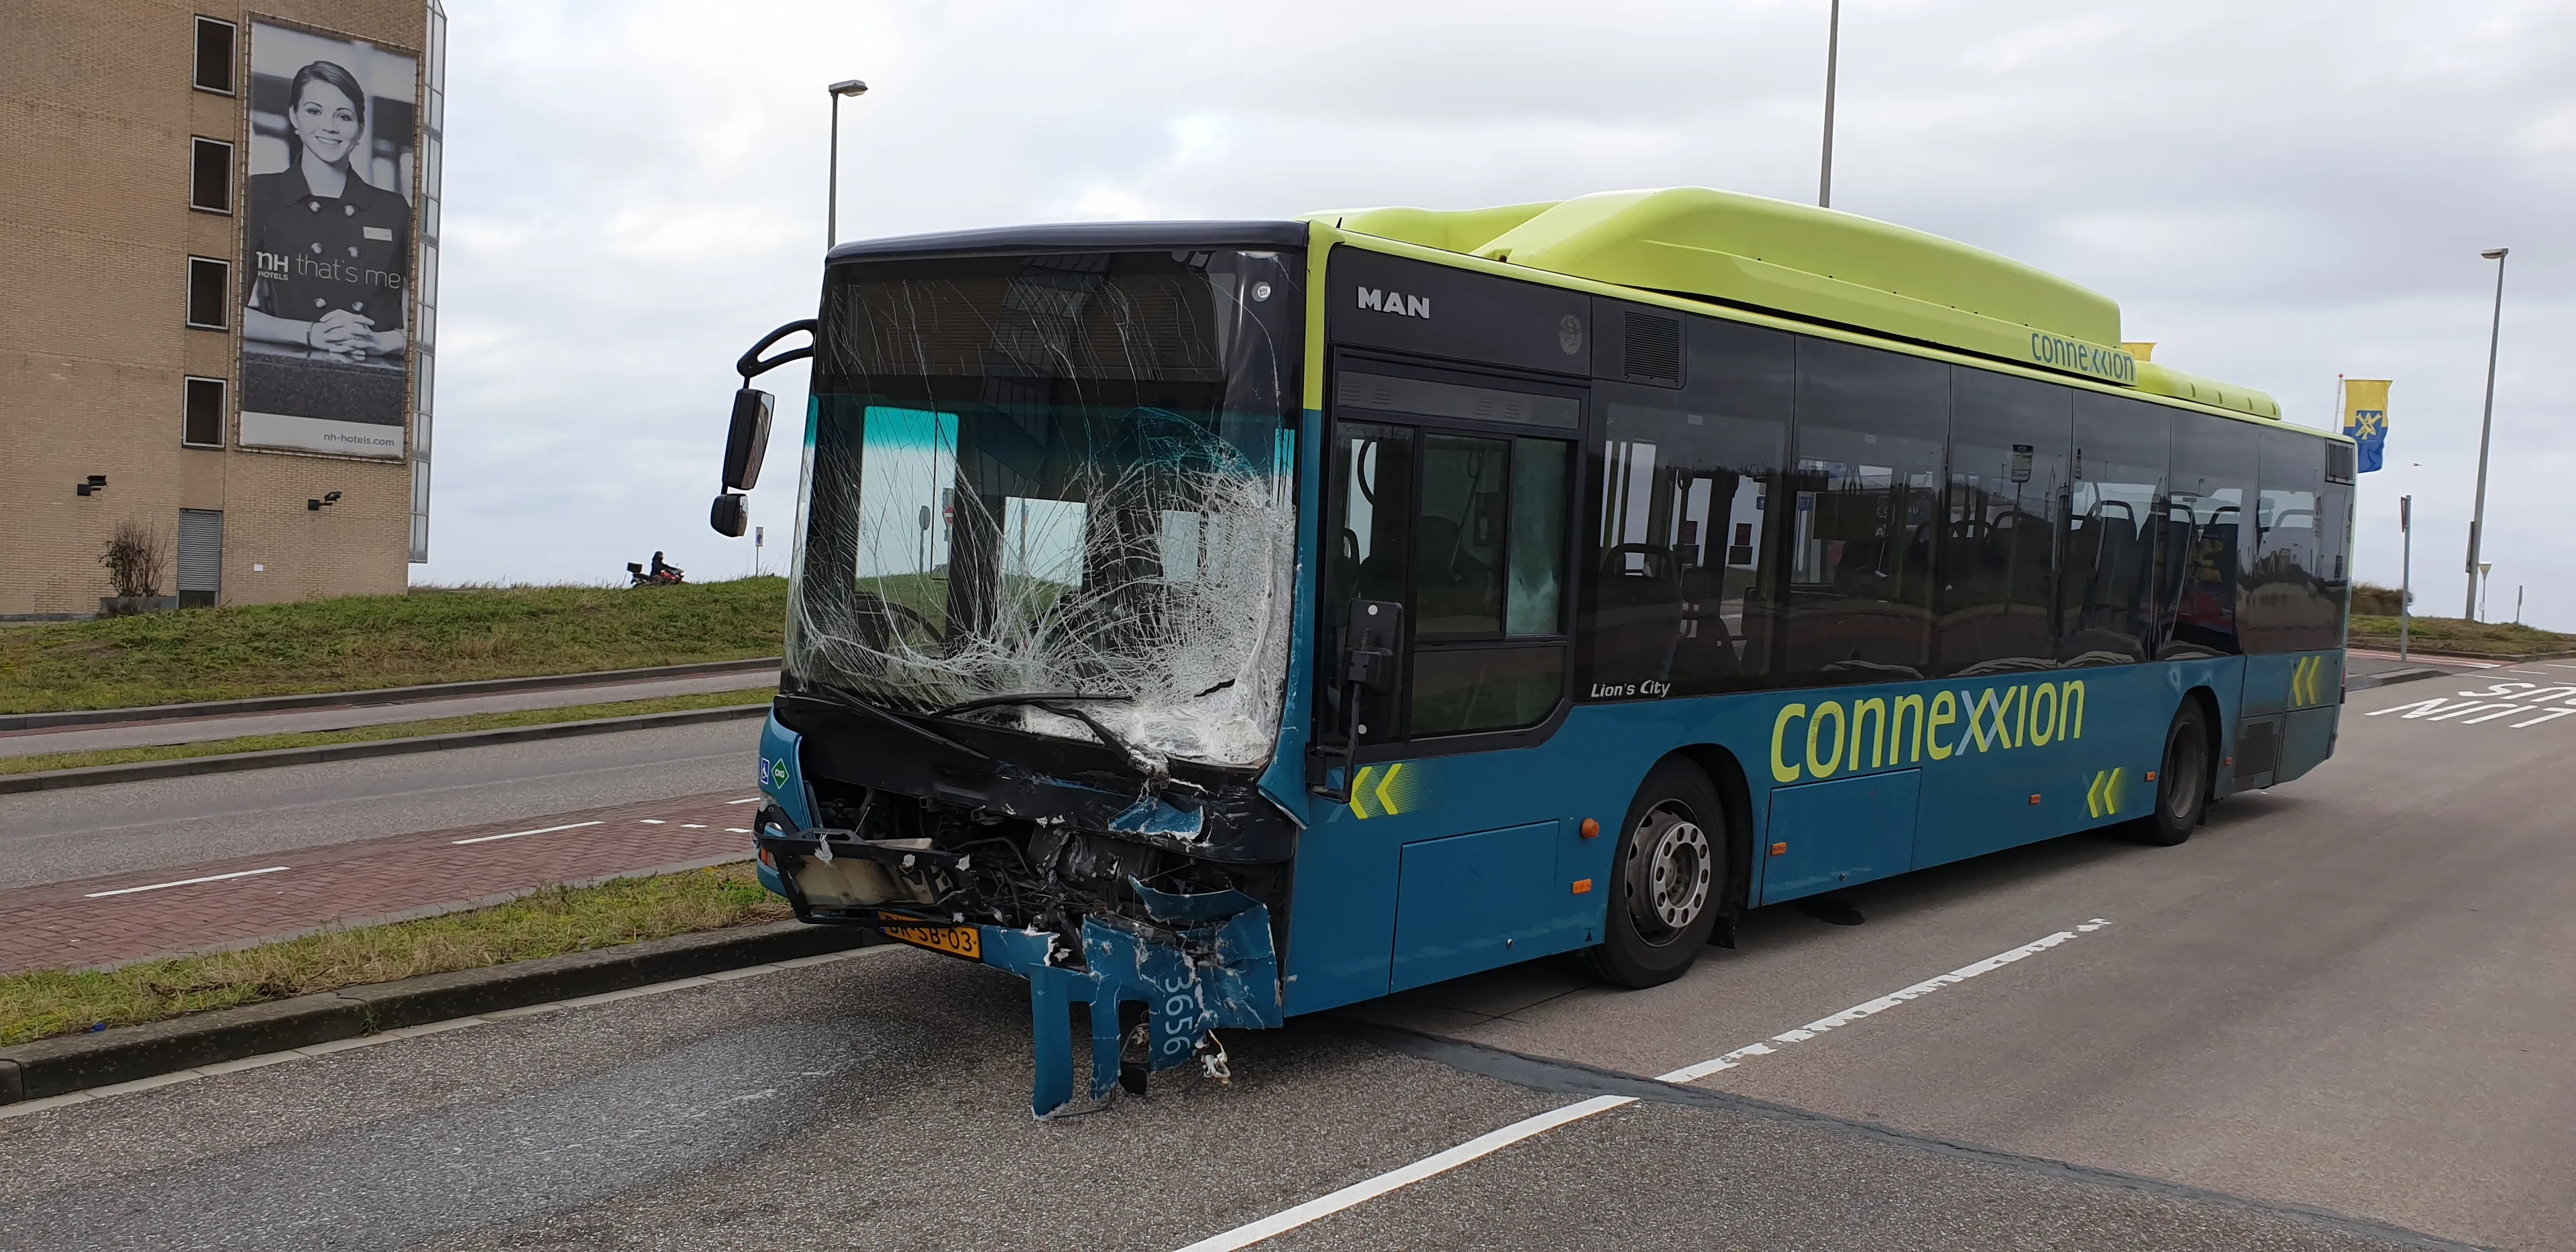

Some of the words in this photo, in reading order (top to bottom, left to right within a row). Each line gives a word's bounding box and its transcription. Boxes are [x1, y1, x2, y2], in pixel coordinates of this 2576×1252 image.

[258, 270, 288, 280] HOTELS
[296, 253, 358, 283] that's
[365, 269, 401, 289] me
[1357, 286, 1430, 319] MAN
[2031, 333, 2134, 382] connexxion
[323, 433, 395, 447] nh-hotels.com
[1591, 683, 1635, 697] Lion's
[1640, 679, 1671, 697] City
[1770, 680, 2086, 783] connexxion
[1163, 973, 1194, 1056] 3656
